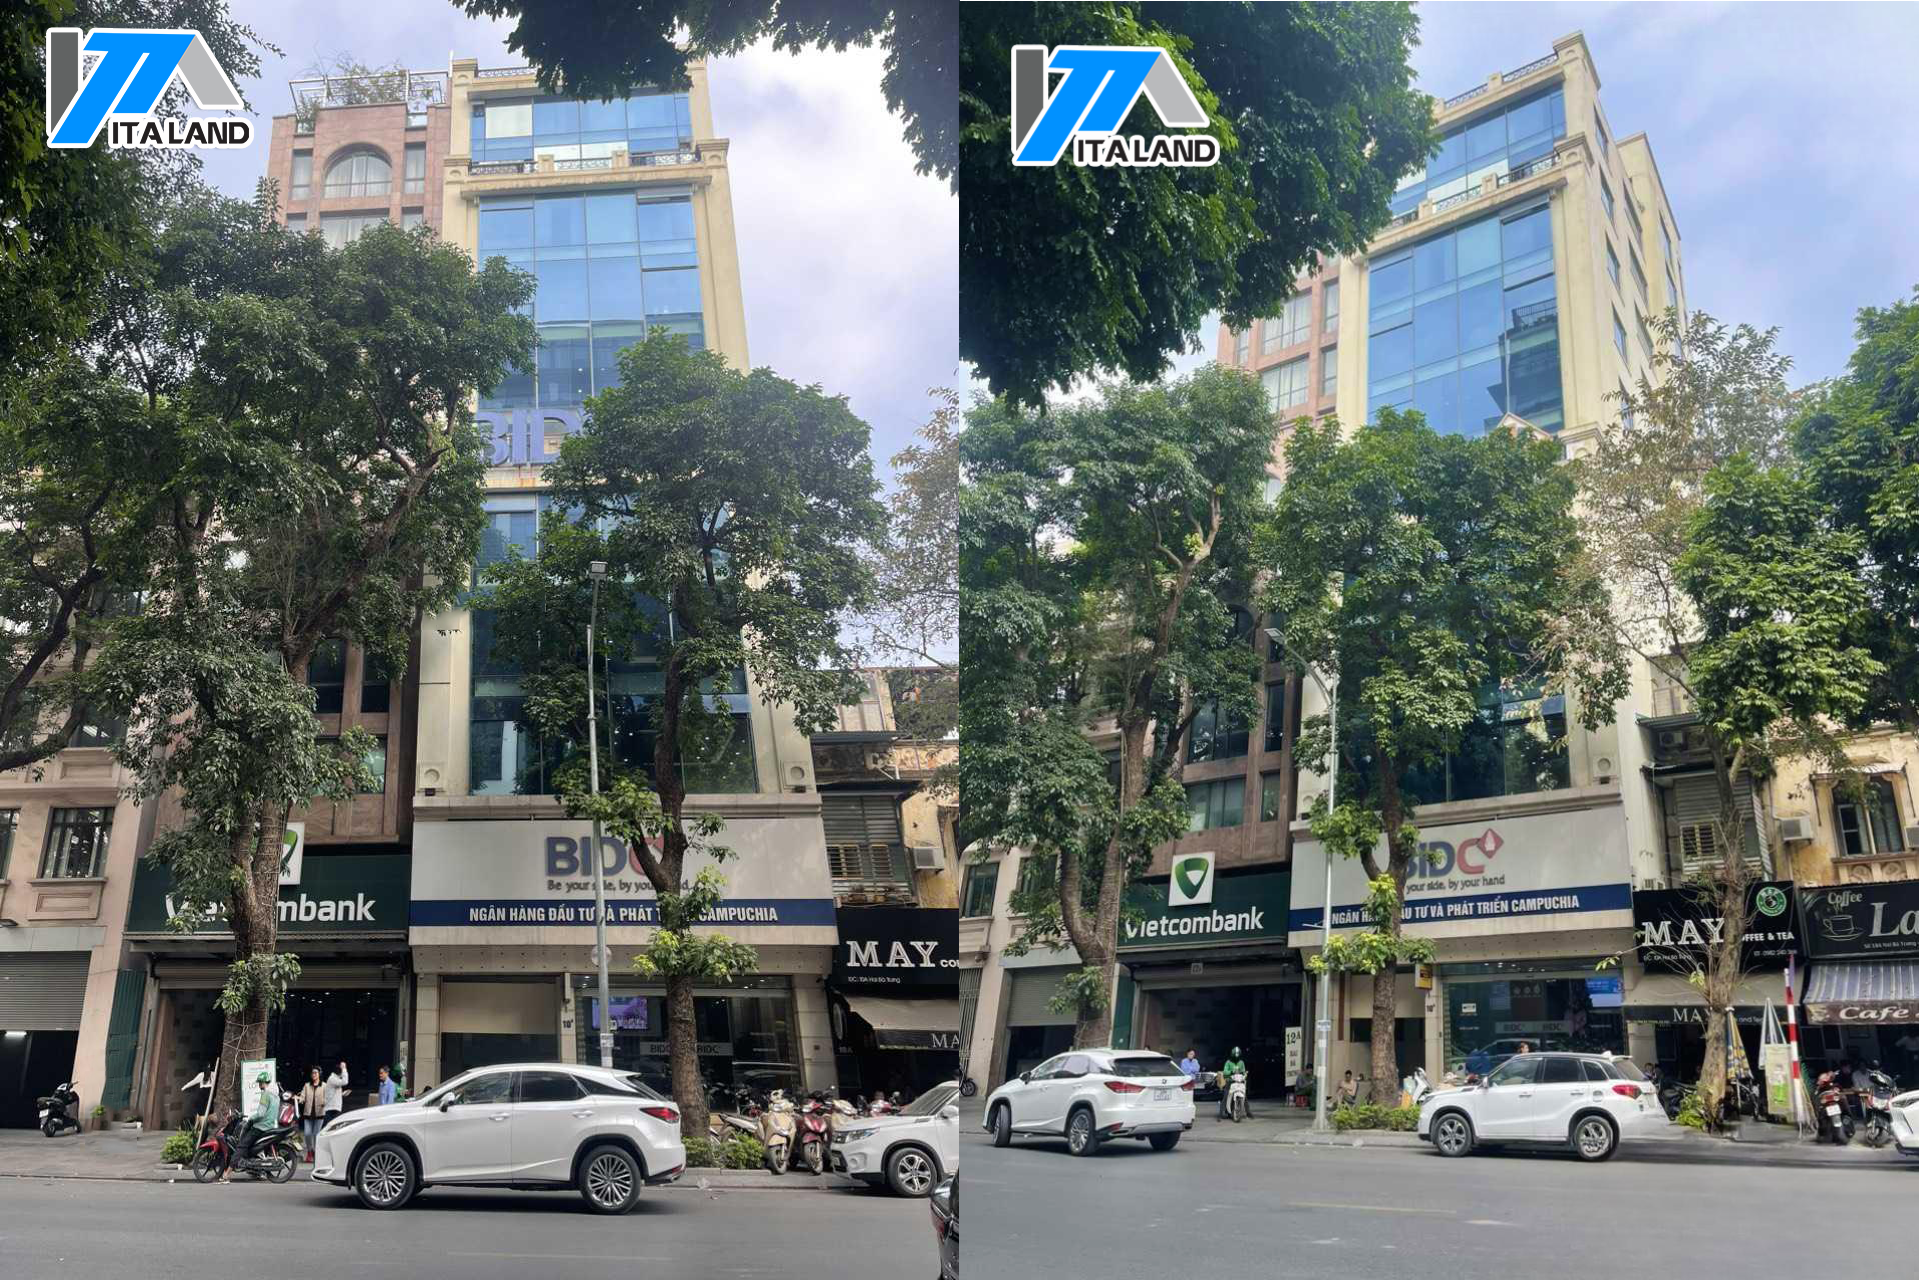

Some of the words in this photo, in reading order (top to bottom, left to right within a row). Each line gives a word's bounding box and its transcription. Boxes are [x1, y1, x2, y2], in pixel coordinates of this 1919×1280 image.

[547, 880, 561, 890] Be
[566, 881, 590, 893] your
[619, 880, 632, 892] by
[636, 881, 656, 893] you
[1460, 879, 1480, 890] your
[1482, 874, 1505, 886] hand
[1828, 890, 1863, 907] Coffee
[470, 905, 506, 921] NGÂN
[509, 905, 545, 921] HÀNG
[619, 904, 652, 921] PHÁT
[699, 907, 778, 921] CAMPUCHIA
[1332, 909, 1359, 924] NGÂN
[1415, 905, 1429, 919] TƯ
[1430, 903, 1444, 918] VÀ
[1447, 901, 1475, 916] PHÁT
[1511, 895, 1580, 913] CAMPUCHIA
[1642, 918, 1725, 946] MAY
[1768, 932, 1775, 941] &
[1776, 931, 1795, 941] TEA
[846, 941, 938, 967] MAY
[1840, 1006, 1909, 1021] Cafe
[1286, 1030, 1301, 1045] 12A
